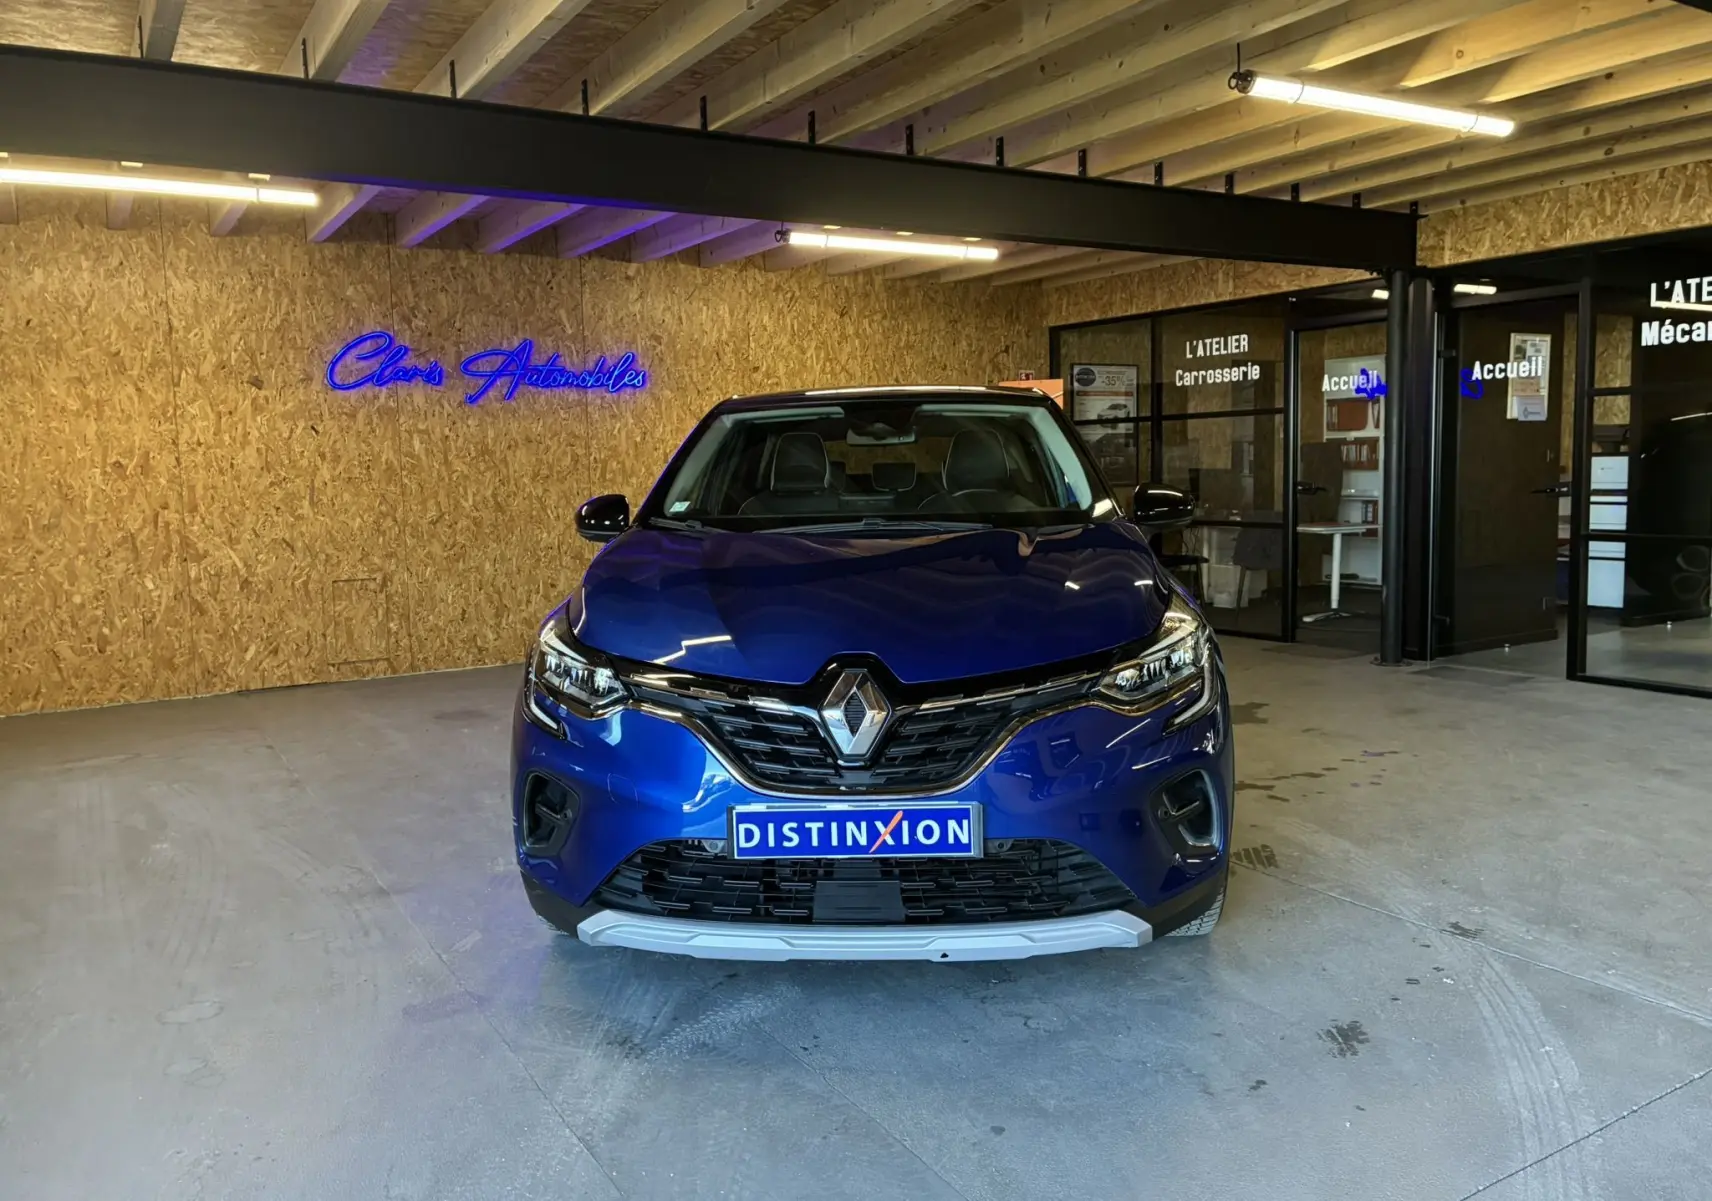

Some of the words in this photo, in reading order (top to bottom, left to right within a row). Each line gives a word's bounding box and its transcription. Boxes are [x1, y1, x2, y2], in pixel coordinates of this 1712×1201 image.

[1186, 334, 1249, 359] L'ATELIER
[326, 330, 443, 391] Claris
[459, 338, 648, 405] Automobiles
[1175, 362, 1261, 387] Carrosserie
[1471, 355, 1543, 381] Accueil
[1321, 369, 1379, 393] Accueil
[738, 811, 970, 854] DISTINXION
